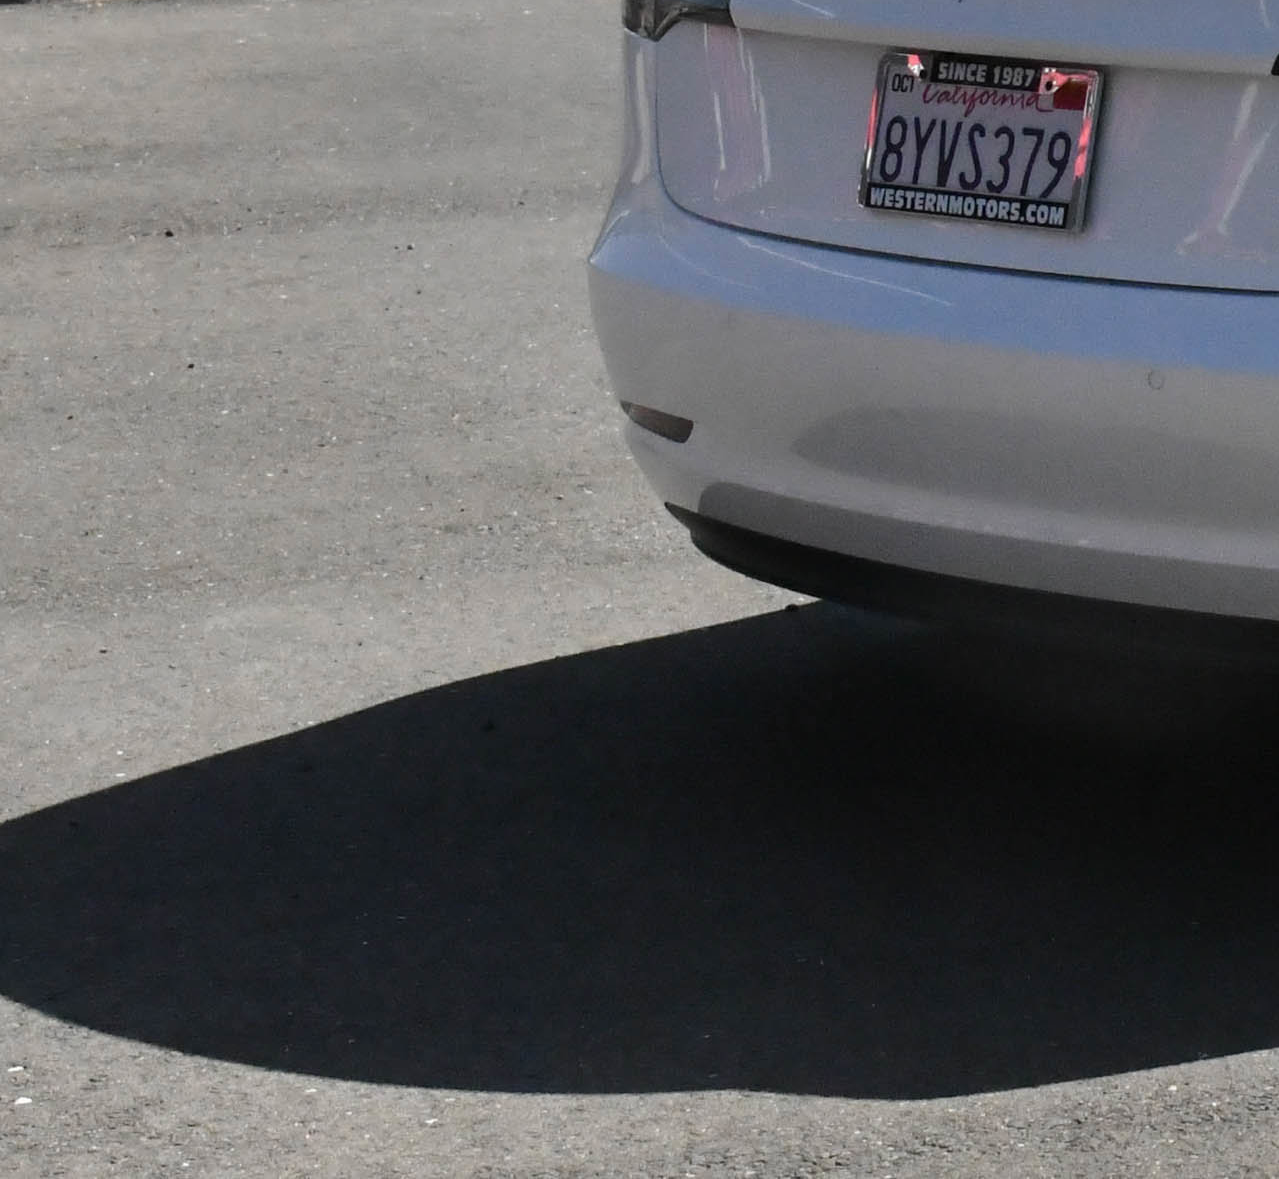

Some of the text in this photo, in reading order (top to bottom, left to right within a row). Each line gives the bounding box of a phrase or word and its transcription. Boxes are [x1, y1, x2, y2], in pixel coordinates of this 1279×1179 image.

[937, 61, 1036, 87] SINCE 1987
[879, 115, 1072, 199] 8YVS379
[870, 187, 1066, 227] WESTERNMOTORS.COM
